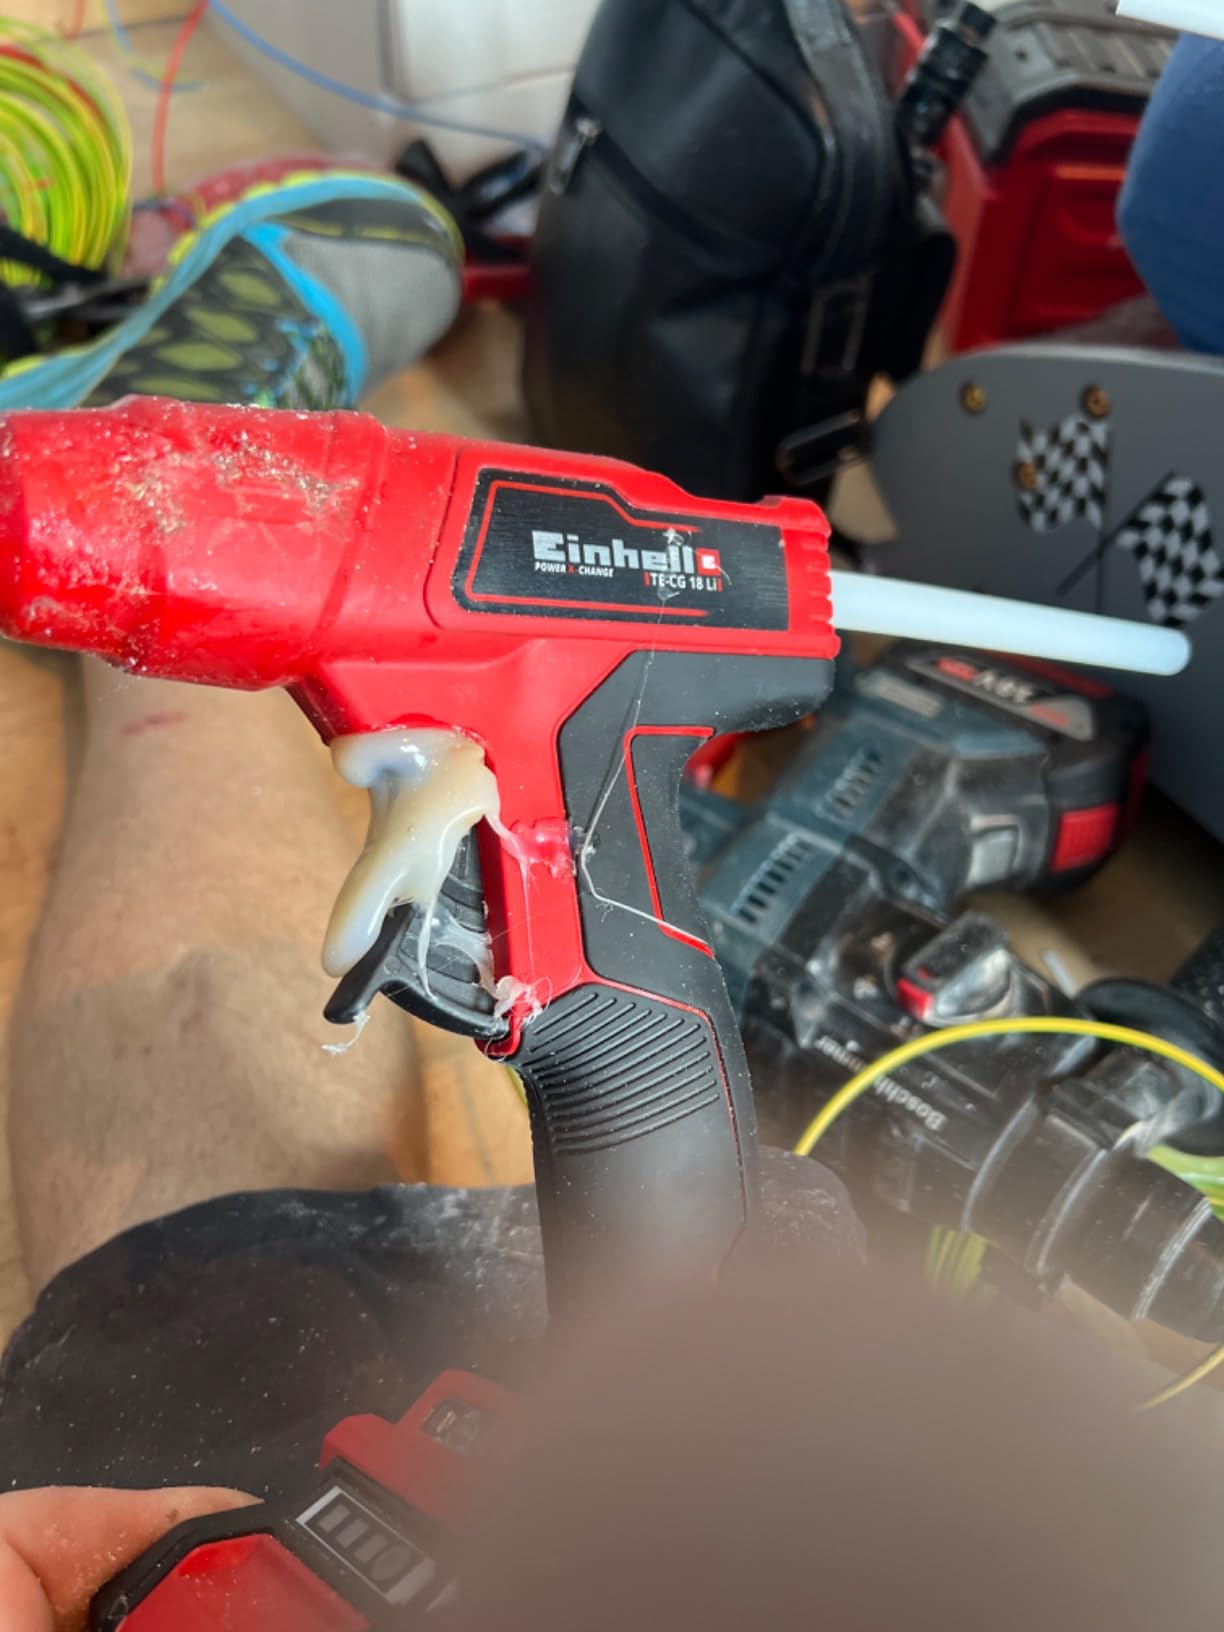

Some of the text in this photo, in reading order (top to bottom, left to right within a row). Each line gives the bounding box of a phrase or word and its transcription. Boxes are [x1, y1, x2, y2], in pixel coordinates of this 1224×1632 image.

[532, 530, 695, 574] Einhell
[534, 561, 566, 573] POWER
[650, 572, 717, 591] TE-CG 18 Li
